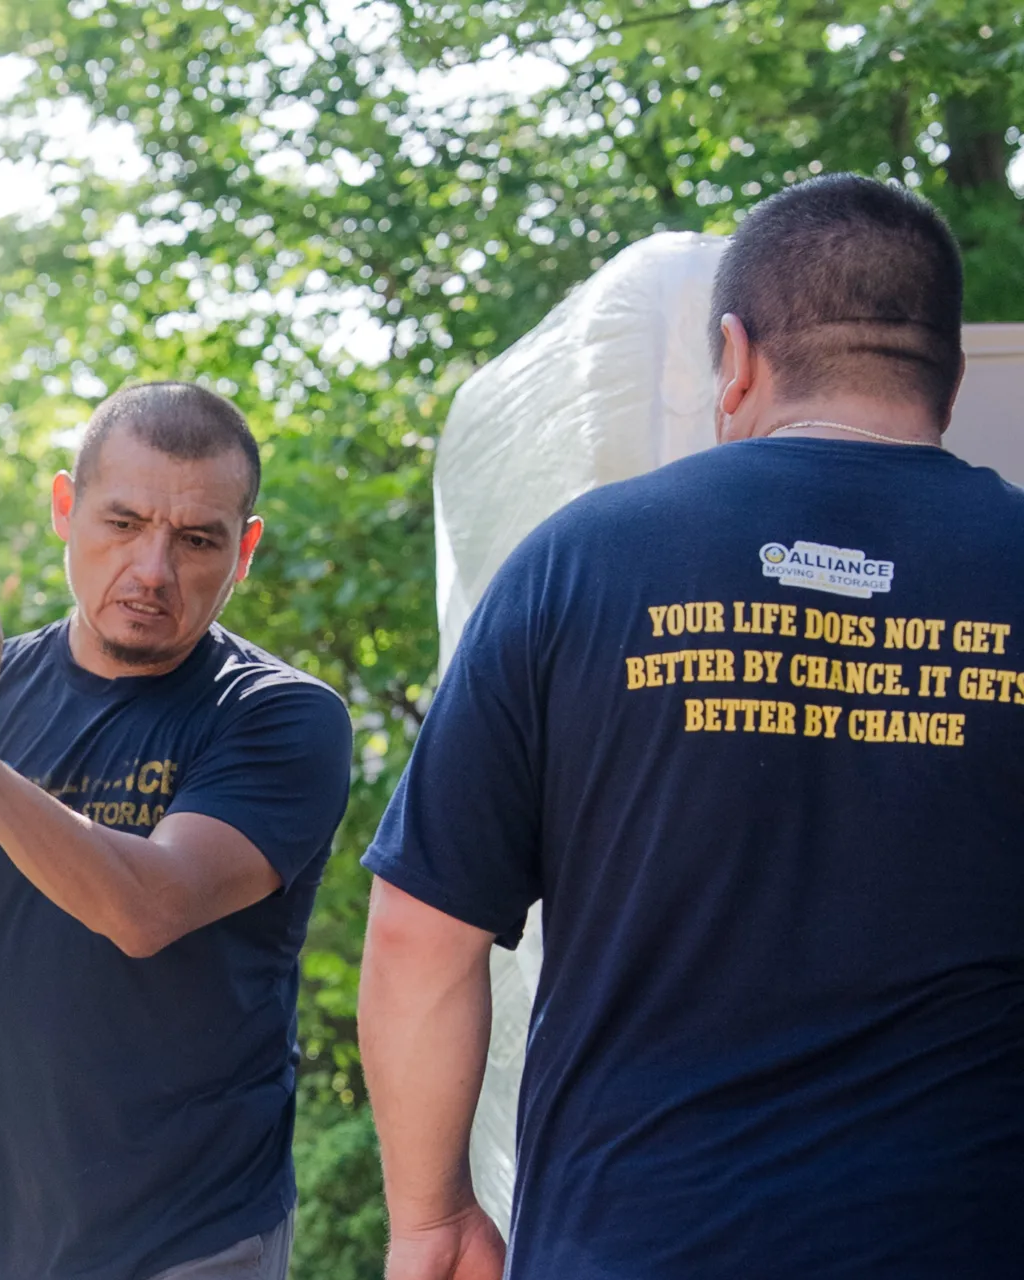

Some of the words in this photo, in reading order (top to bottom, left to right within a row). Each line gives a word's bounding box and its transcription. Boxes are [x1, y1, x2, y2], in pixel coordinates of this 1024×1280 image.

[766, 565, 815, 580] MOVING
[828, 574, 888, 590] STORAGE
[789, 551, 890, 577] ALLIANCE
[648, 601, 725, 638] YOUR
[732, 600, 798, 637] LIFE
[804, 607, 875, 648] DOES
[883, 617, 945, 651] NOT
[952, 620, 1011, 655] GET
[625, 649, 736, 690] BETTER
[743, 650, 783, 684] BY
[789, 653, 910, 696] CHANCE.
[918, 665, 952, 698] IT
[684, 698, 797, 735] BETTER
[803, 703, 843, 739] BY
[848, 708, 966, 746] CHANGE
